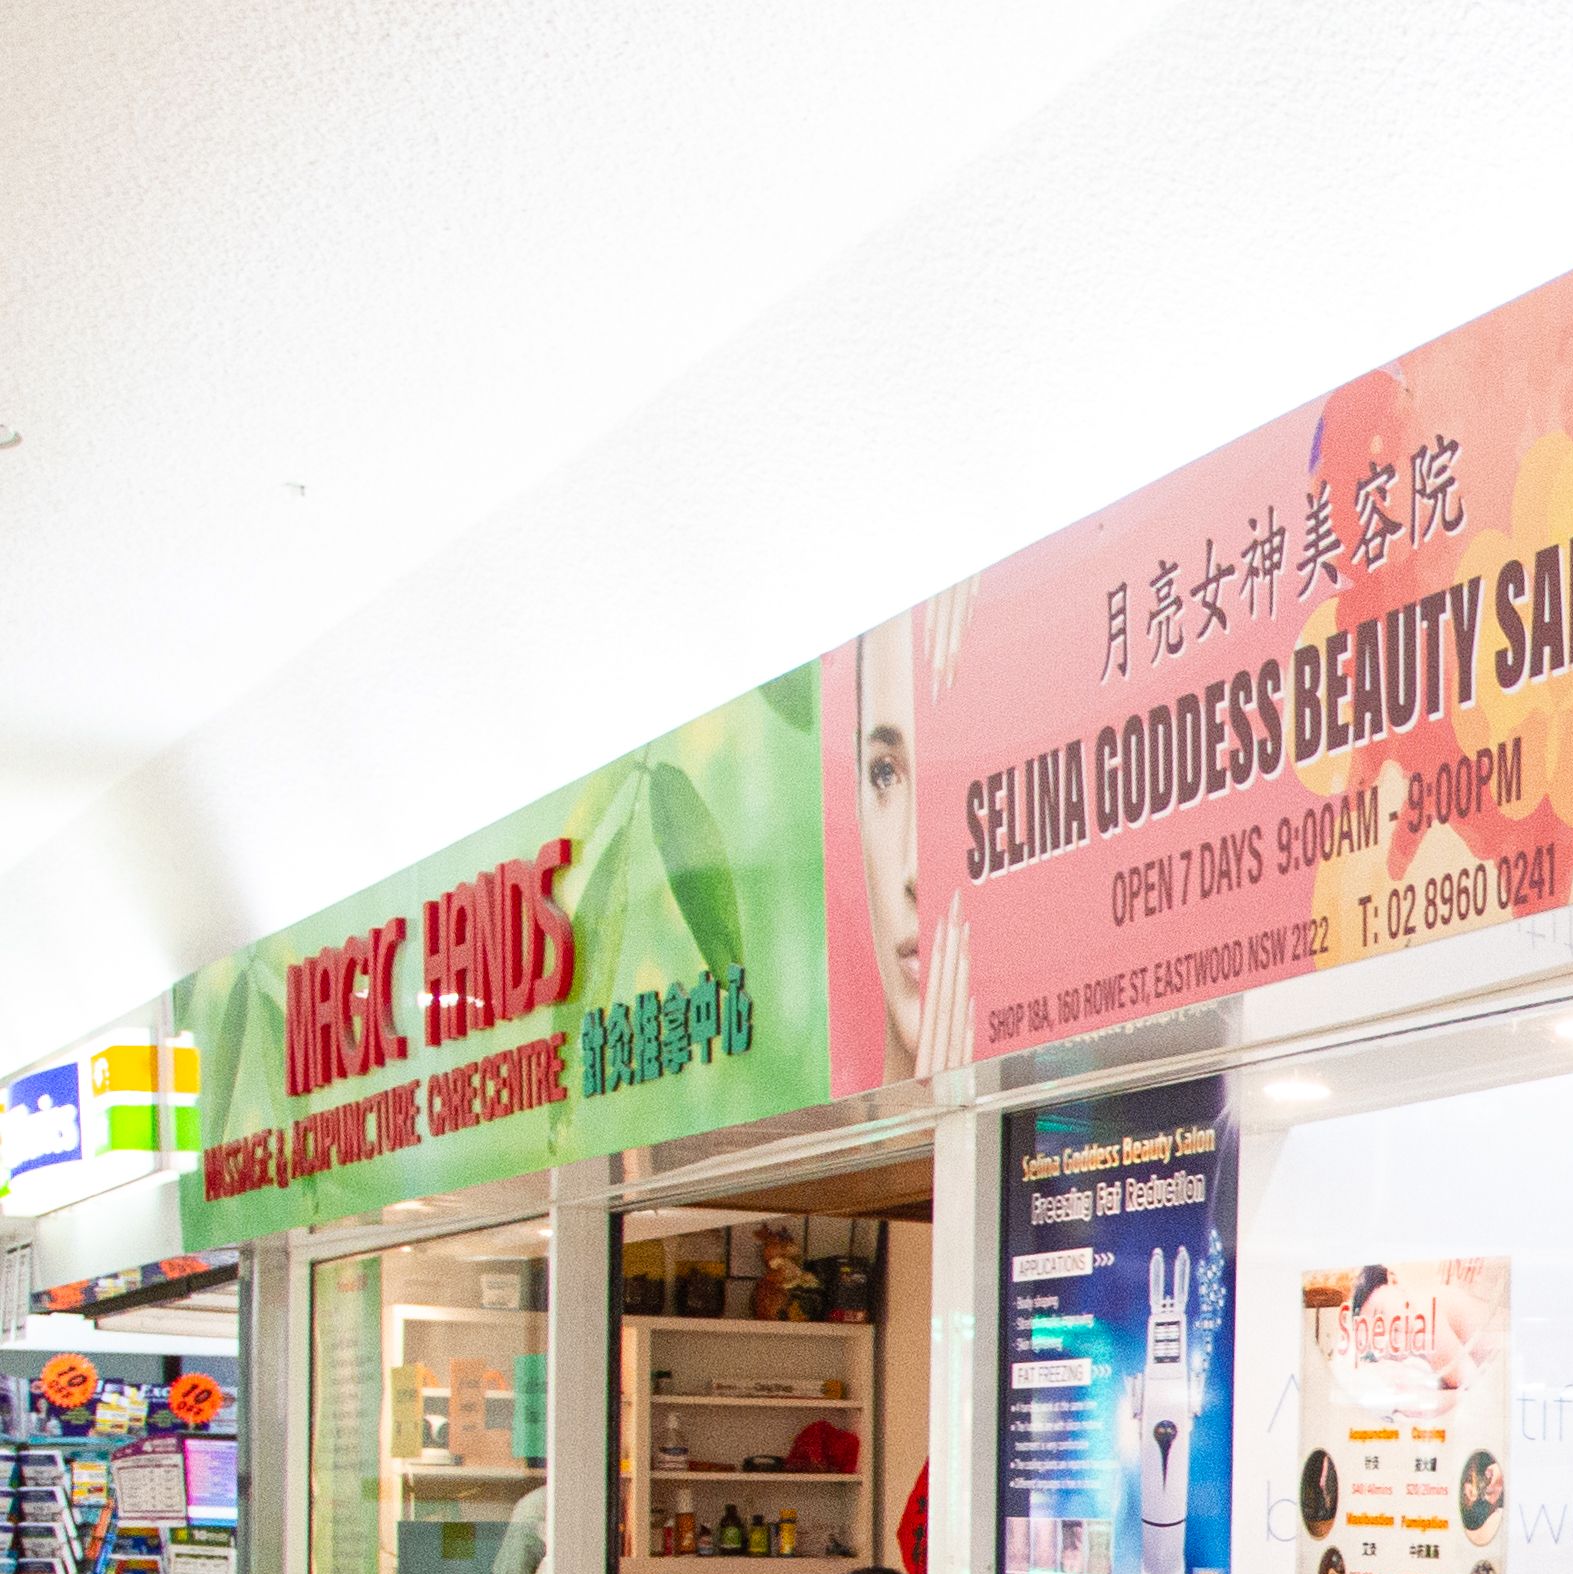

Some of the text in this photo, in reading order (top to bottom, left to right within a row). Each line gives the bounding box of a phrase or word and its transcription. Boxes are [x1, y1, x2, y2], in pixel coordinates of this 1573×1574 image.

[1099, 434, 1465, 685] 月亮女神美容院
[964, 735, 1090, 886] SELINA
[1094, 659, 1285, 837] GODDESS
[1293, 577, 1485, 769] BEAUTY
[1111, 736, 1524, 929] OPEN 7 DAYS 9:00AM 9:00PM
[1357, 843, 1555, 949] T: 02 8960 0241
[286, 838, 574, 1097] MAGIC HANDS
[988, 1003, 1025, 1044] SHOP
[1057, 986, 1081, 1025] 160
[1083, 973, 1127, 1020] ROWE
[1152, 940, 1244, 999] EASTWOOD
[1247, 926, 1288, 973] NSW
[1291, 915, 1330, 962] 2122
[291, 1078, 422, 1180] ACUPUNCTURE
[1022, 1125, 1216, 1182] Selina Goddess Beauty Salon
[1125, 1170, 1206, 1212] Reduction
[1338, 1296, 1437, 1368] Special
